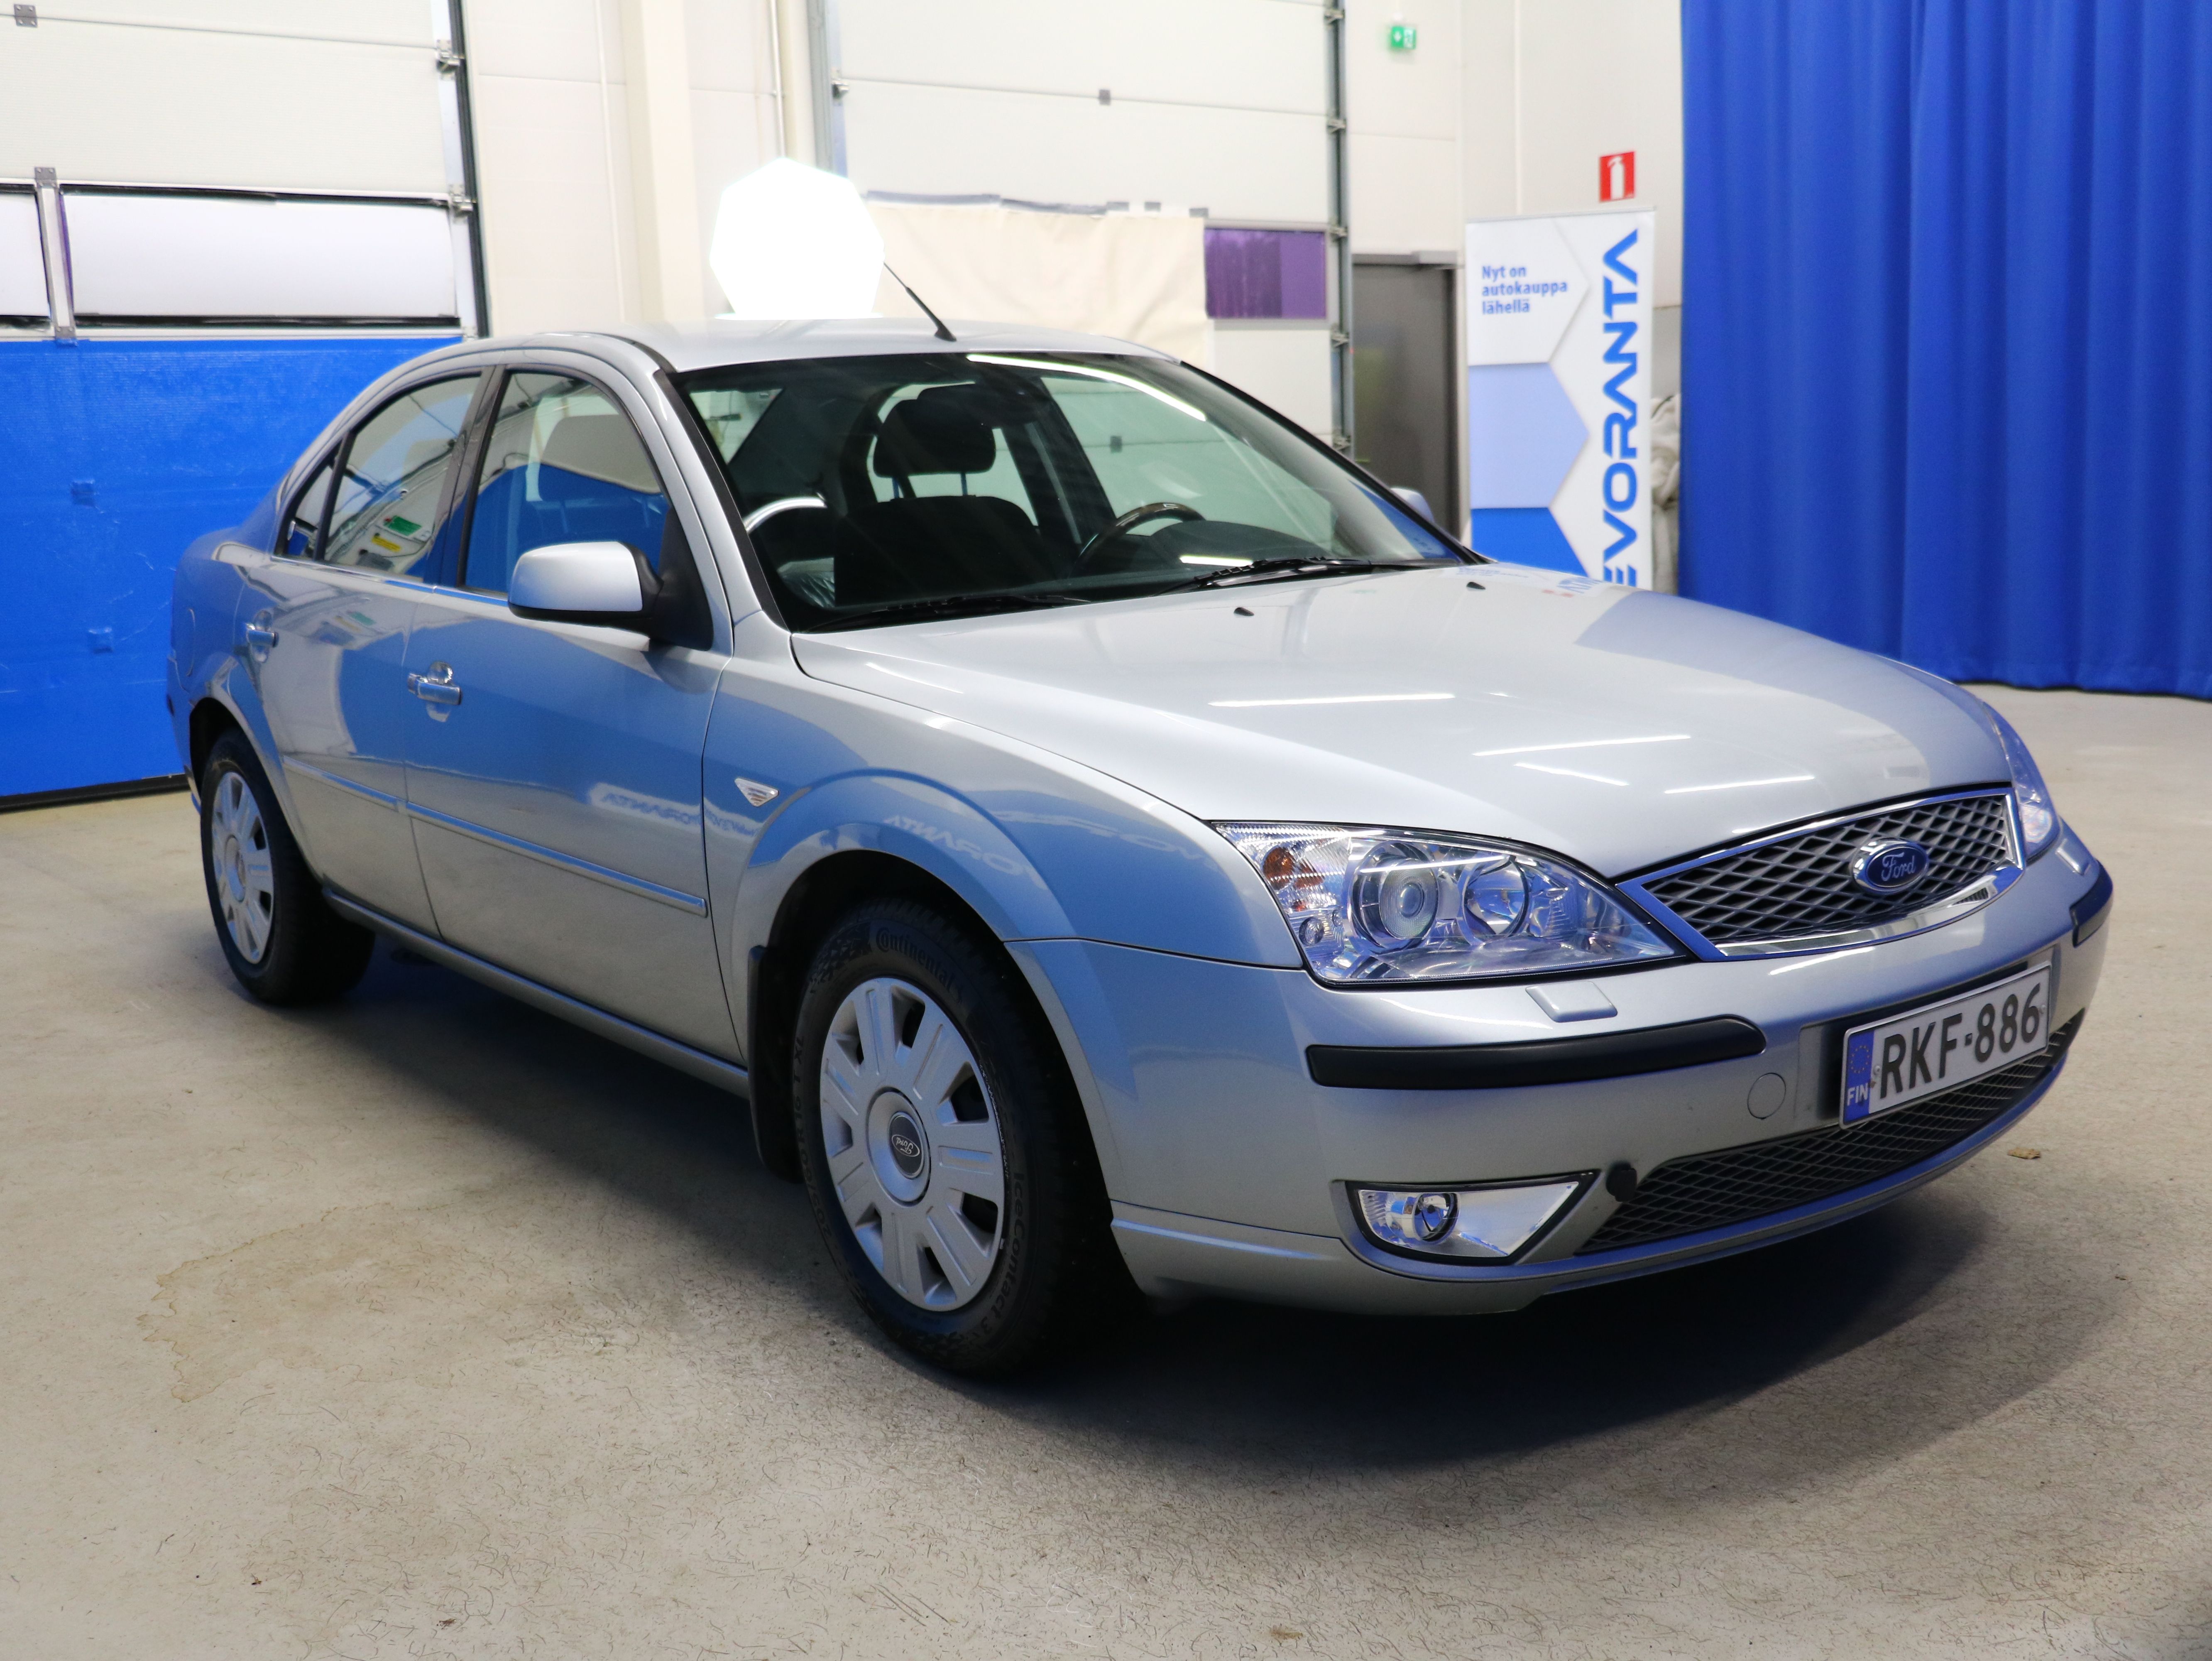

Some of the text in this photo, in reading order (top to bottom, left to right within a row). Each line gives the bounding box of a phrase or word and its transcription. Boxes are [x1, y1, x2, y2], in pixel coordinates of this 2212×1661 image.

[1482, 266, 1526, 282] Nyt on
[1482, 281, 1568, 296] autokauppa
[1482, 299, 1529, 314] lähellä
[1881, 852, 1916, 881] Ford
[1879, 982, 2040, 1099] RKF-886
[1847, 1083, 1868, 1106] FIN
[896, 1137, 914, 1154] Ford
